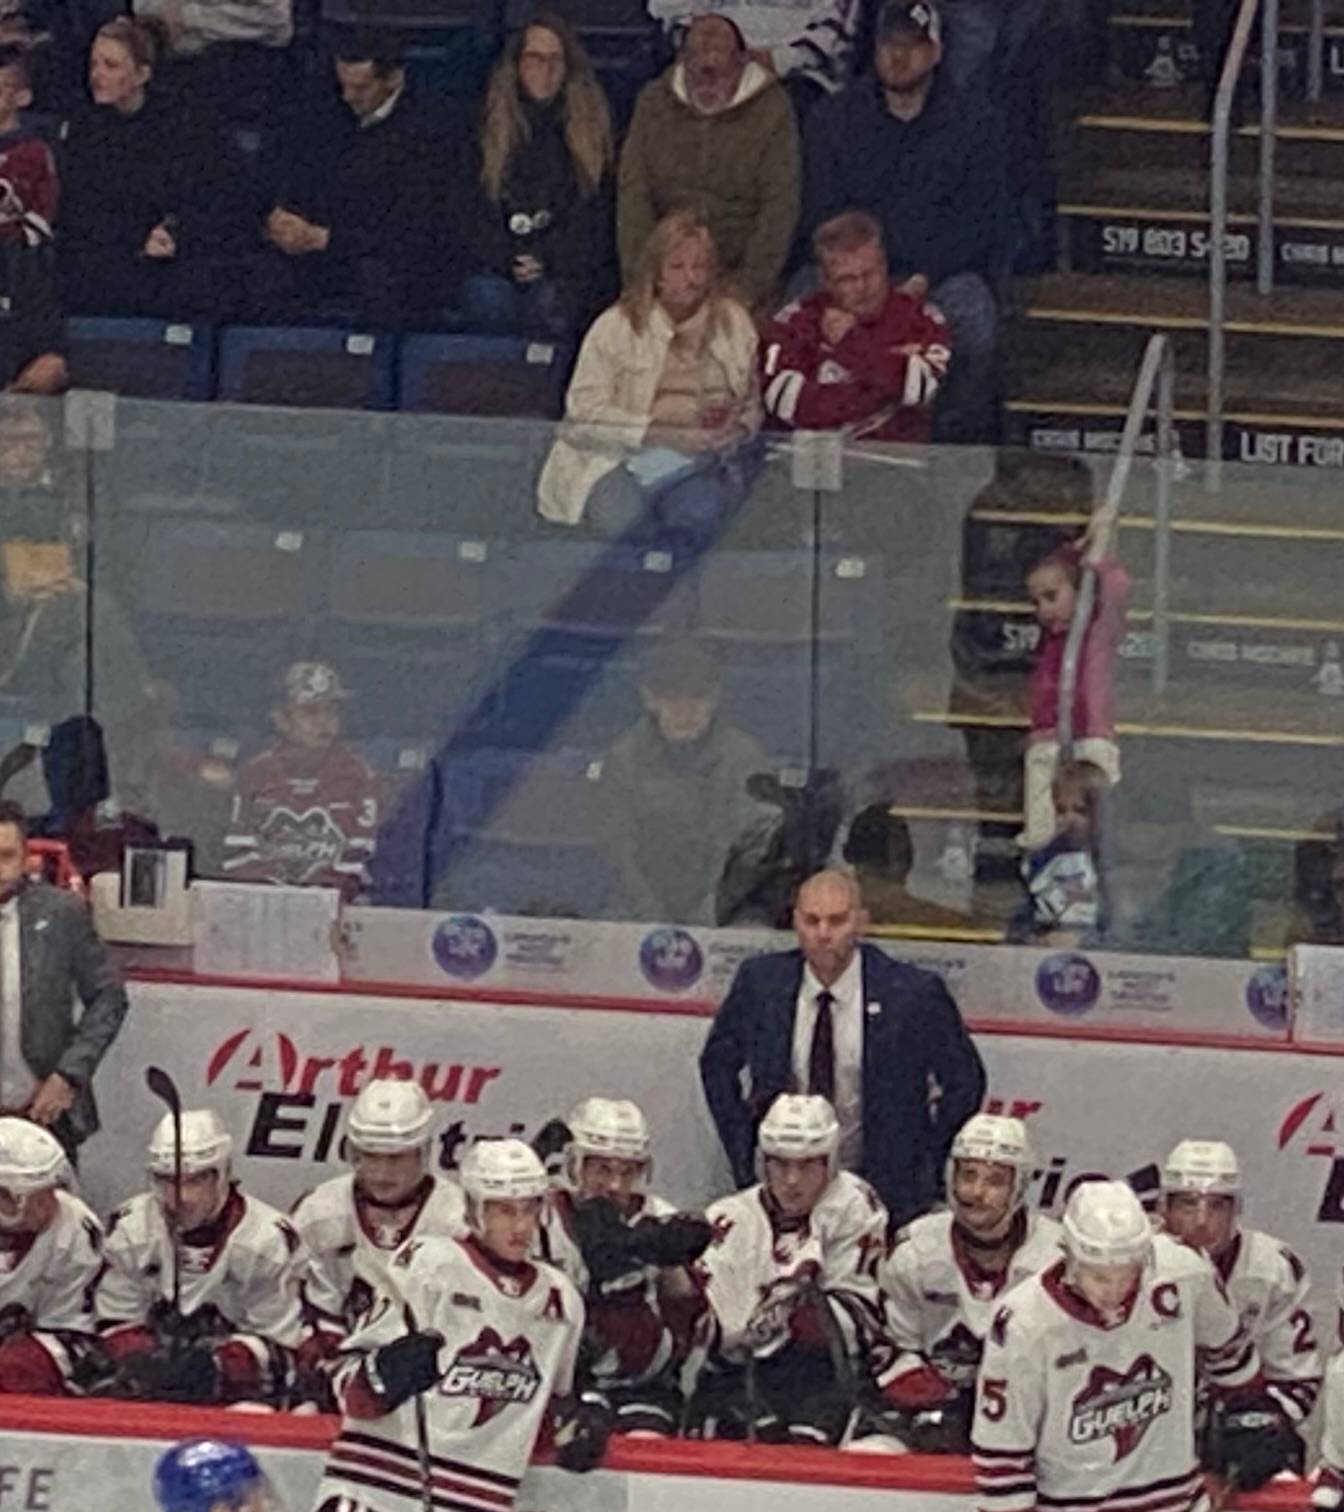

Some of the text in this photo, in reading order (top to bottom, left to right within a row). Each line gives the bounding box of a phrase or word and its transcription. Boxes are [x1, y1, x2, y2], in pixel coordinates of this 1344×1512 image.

[1240, 431, 1291, 463] LIST
[207, 1027, 501, 1104] Arthur
[544, 1286, 565, 1322] A
[1150, 1283, 1181, 1319] C
[1289, 1310, 1318, 1354] 2
[981, 1378, 1009, 1423] 5
[1071, 1390, 1172, 1441] GUELPH
